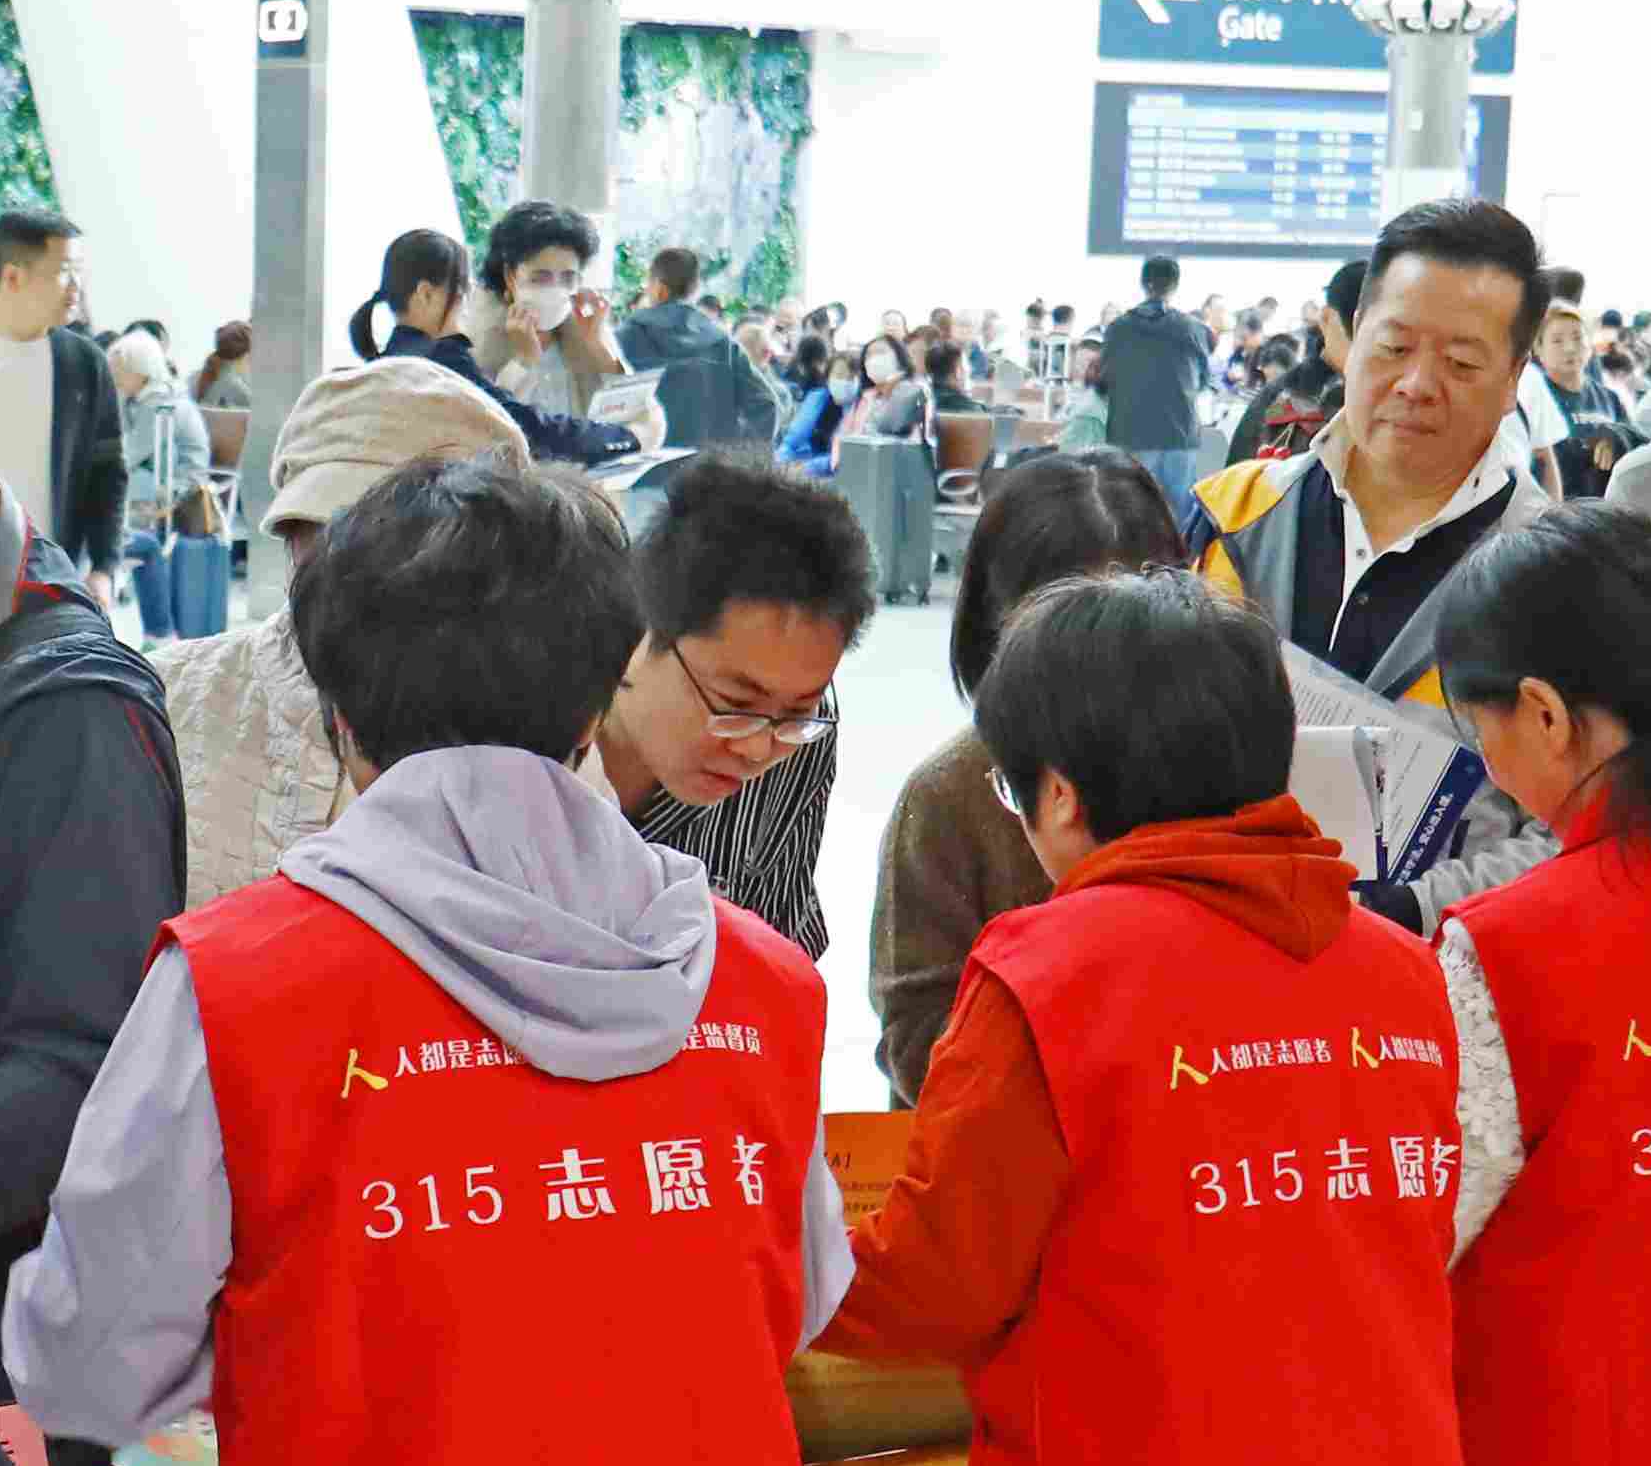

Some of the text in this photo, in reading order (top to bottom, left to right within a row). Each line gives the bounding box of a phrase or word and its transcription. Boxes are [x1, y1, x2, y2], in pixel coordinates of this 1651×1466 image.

[1217, 5, 1283, 42] Gate
[361, 1134, 768, 1240] 315 志愿者
[1190, 1148, 1304, 1214] 315
